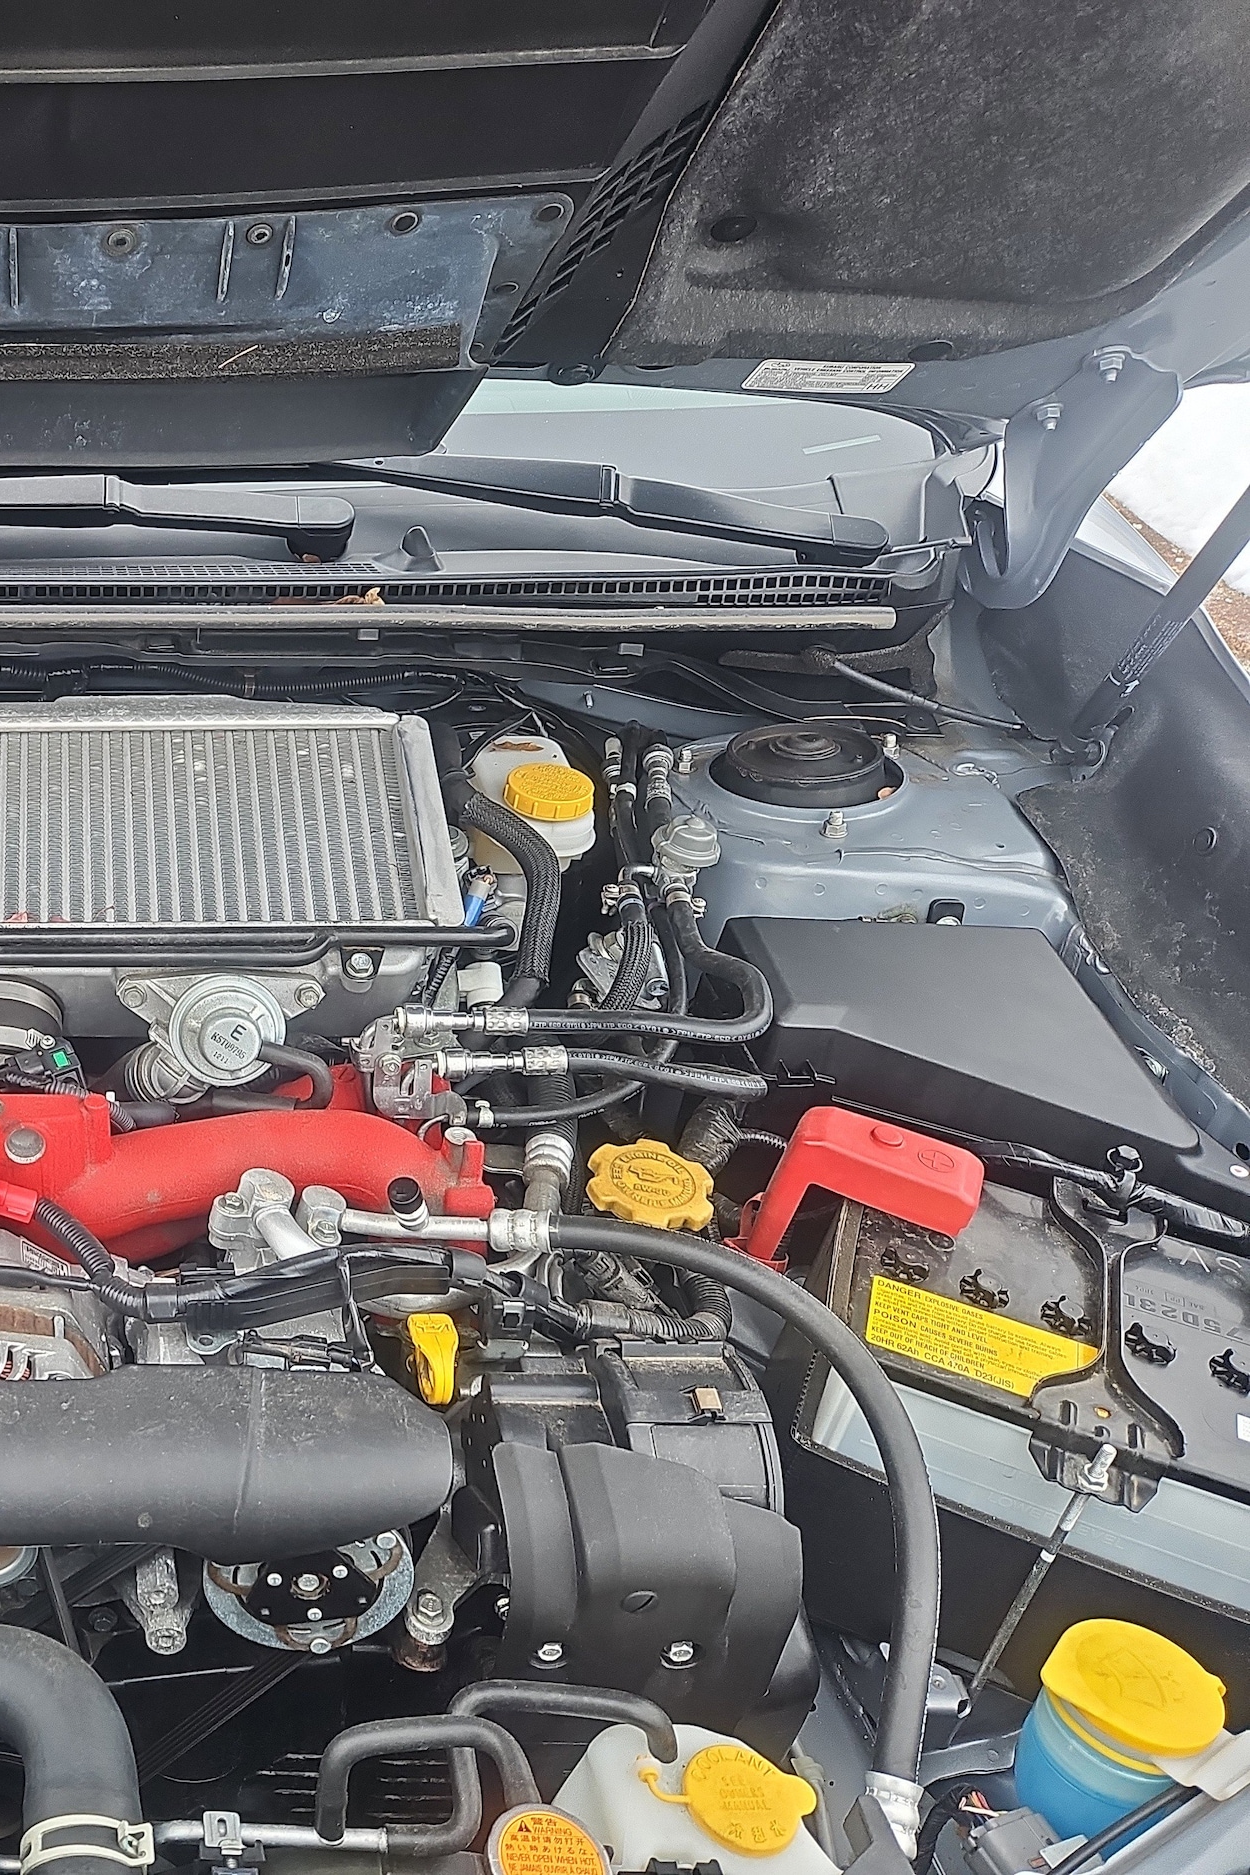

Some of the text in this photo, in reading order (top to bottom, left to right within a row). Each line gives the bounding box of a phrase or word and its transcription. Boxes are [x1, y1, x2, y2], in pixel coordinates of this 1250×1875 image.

[230, 1024, 247, 1042] E
[620, 1151, 684, 1175] ENGINE OIL
[877, 1279, 983, 1320] DANGER EXPLOSIVE GASES
[872, 1308, 999, 1356] POISON CAUSES SEVERE BURNS
[874, 1300, 988, 1343] KEEP VENT CAPS TIGHT AND LEVEL
[1123, 1292, 1243, 1341] 75D23L
[869, 1333, 895, 1347] 20HR
[895, 1342, 920, 1356] 62Ah
[923, 1351, 946, 1365] CCA
[870, 1325, 985, 1369] KEEP OUT OF REACH OF CHILDREN
[690, 1749, 776, 1782] COOLANT
[721, 1775, 746, 1787] SEE
[721, 1799, 772, 1811] MANUAL
[532, 1826, 573, 1837] WARNING
[506, 1852, 531, 1862] NEVER
[532, 1853, 554, 1863] OPEN
[554, 1855, 578, 1865] WHEN
